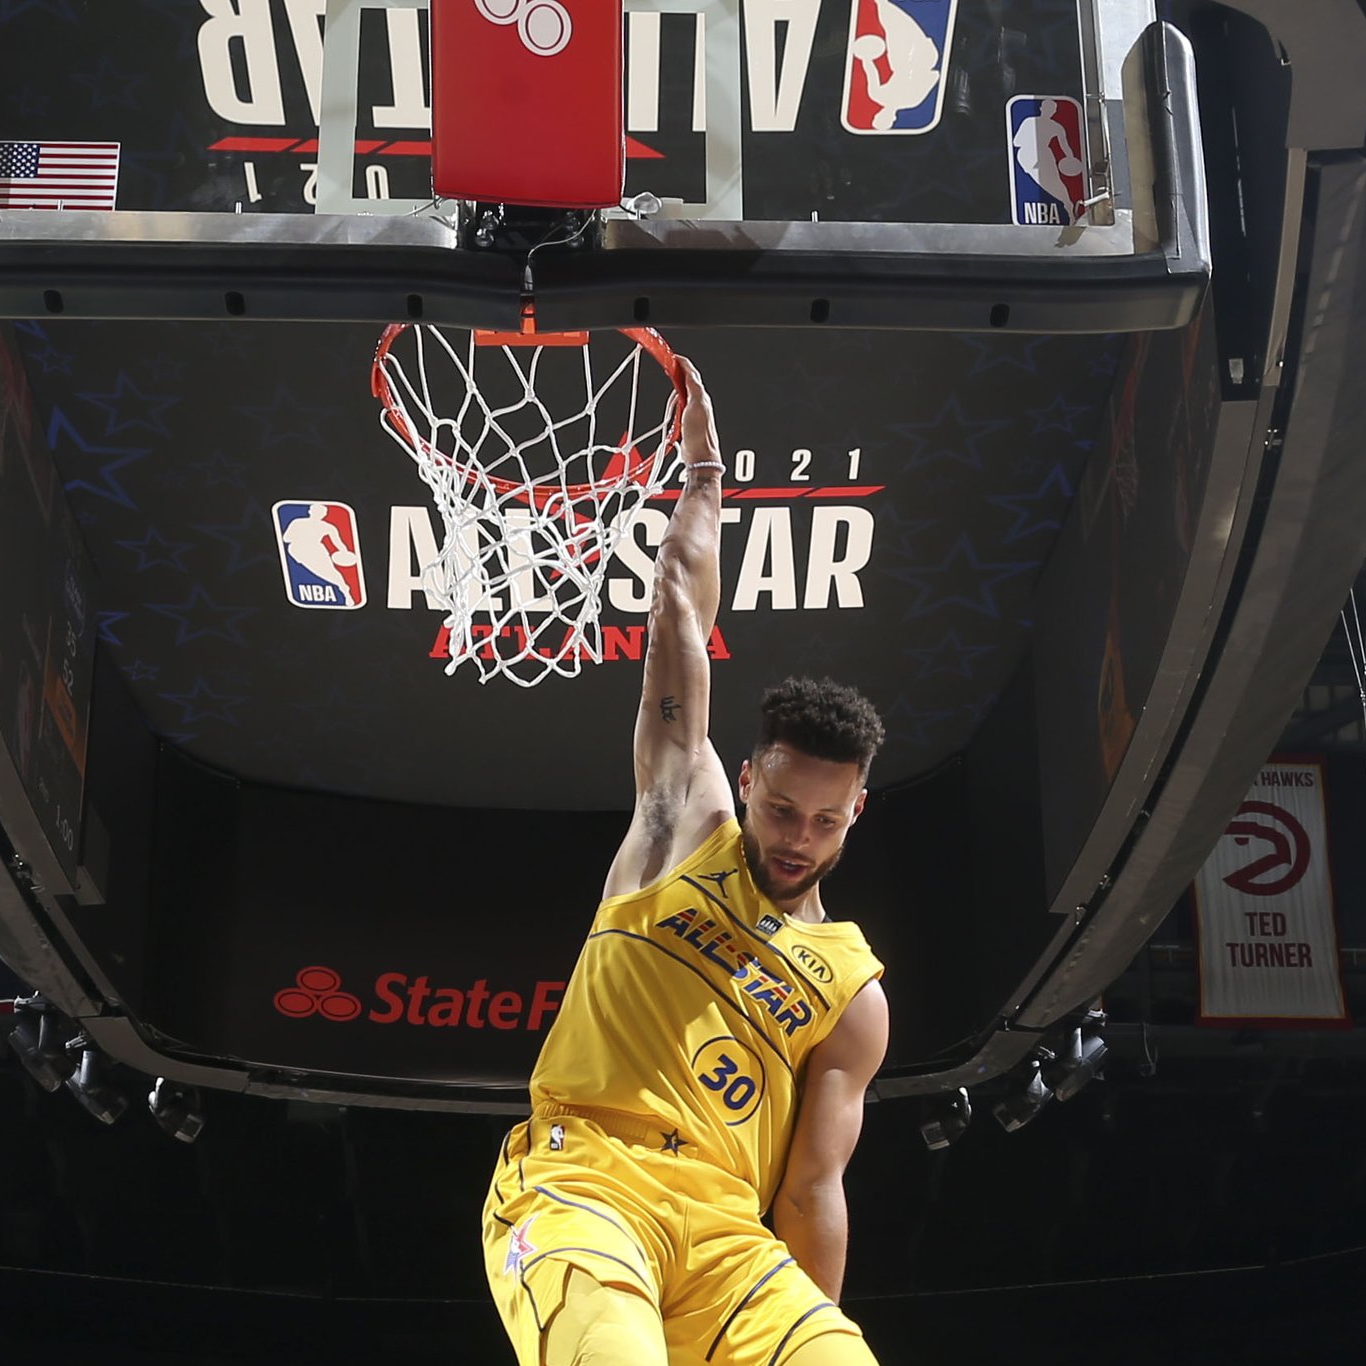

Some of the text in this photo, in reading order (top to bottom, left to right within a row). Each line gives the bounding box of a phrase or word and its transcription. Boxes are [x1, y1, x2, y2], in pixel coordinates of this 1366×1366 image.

[1024, 202, 1060, 224] NBA
[386, 505, 546, 611] ALL
[297, 583, 337, 604] NBA
[428, 624, 732, 660] ATLANA
[1261, 772, 1314, 787] HAWKS
[1245, 912, 1286, 937] TED
[797, 950, 826, 980] KIA
[1226, 943, 1312, 968] TURNER
[368, 972, 566, 1031] StateF
[698, 1054, 756, 1110] 30
